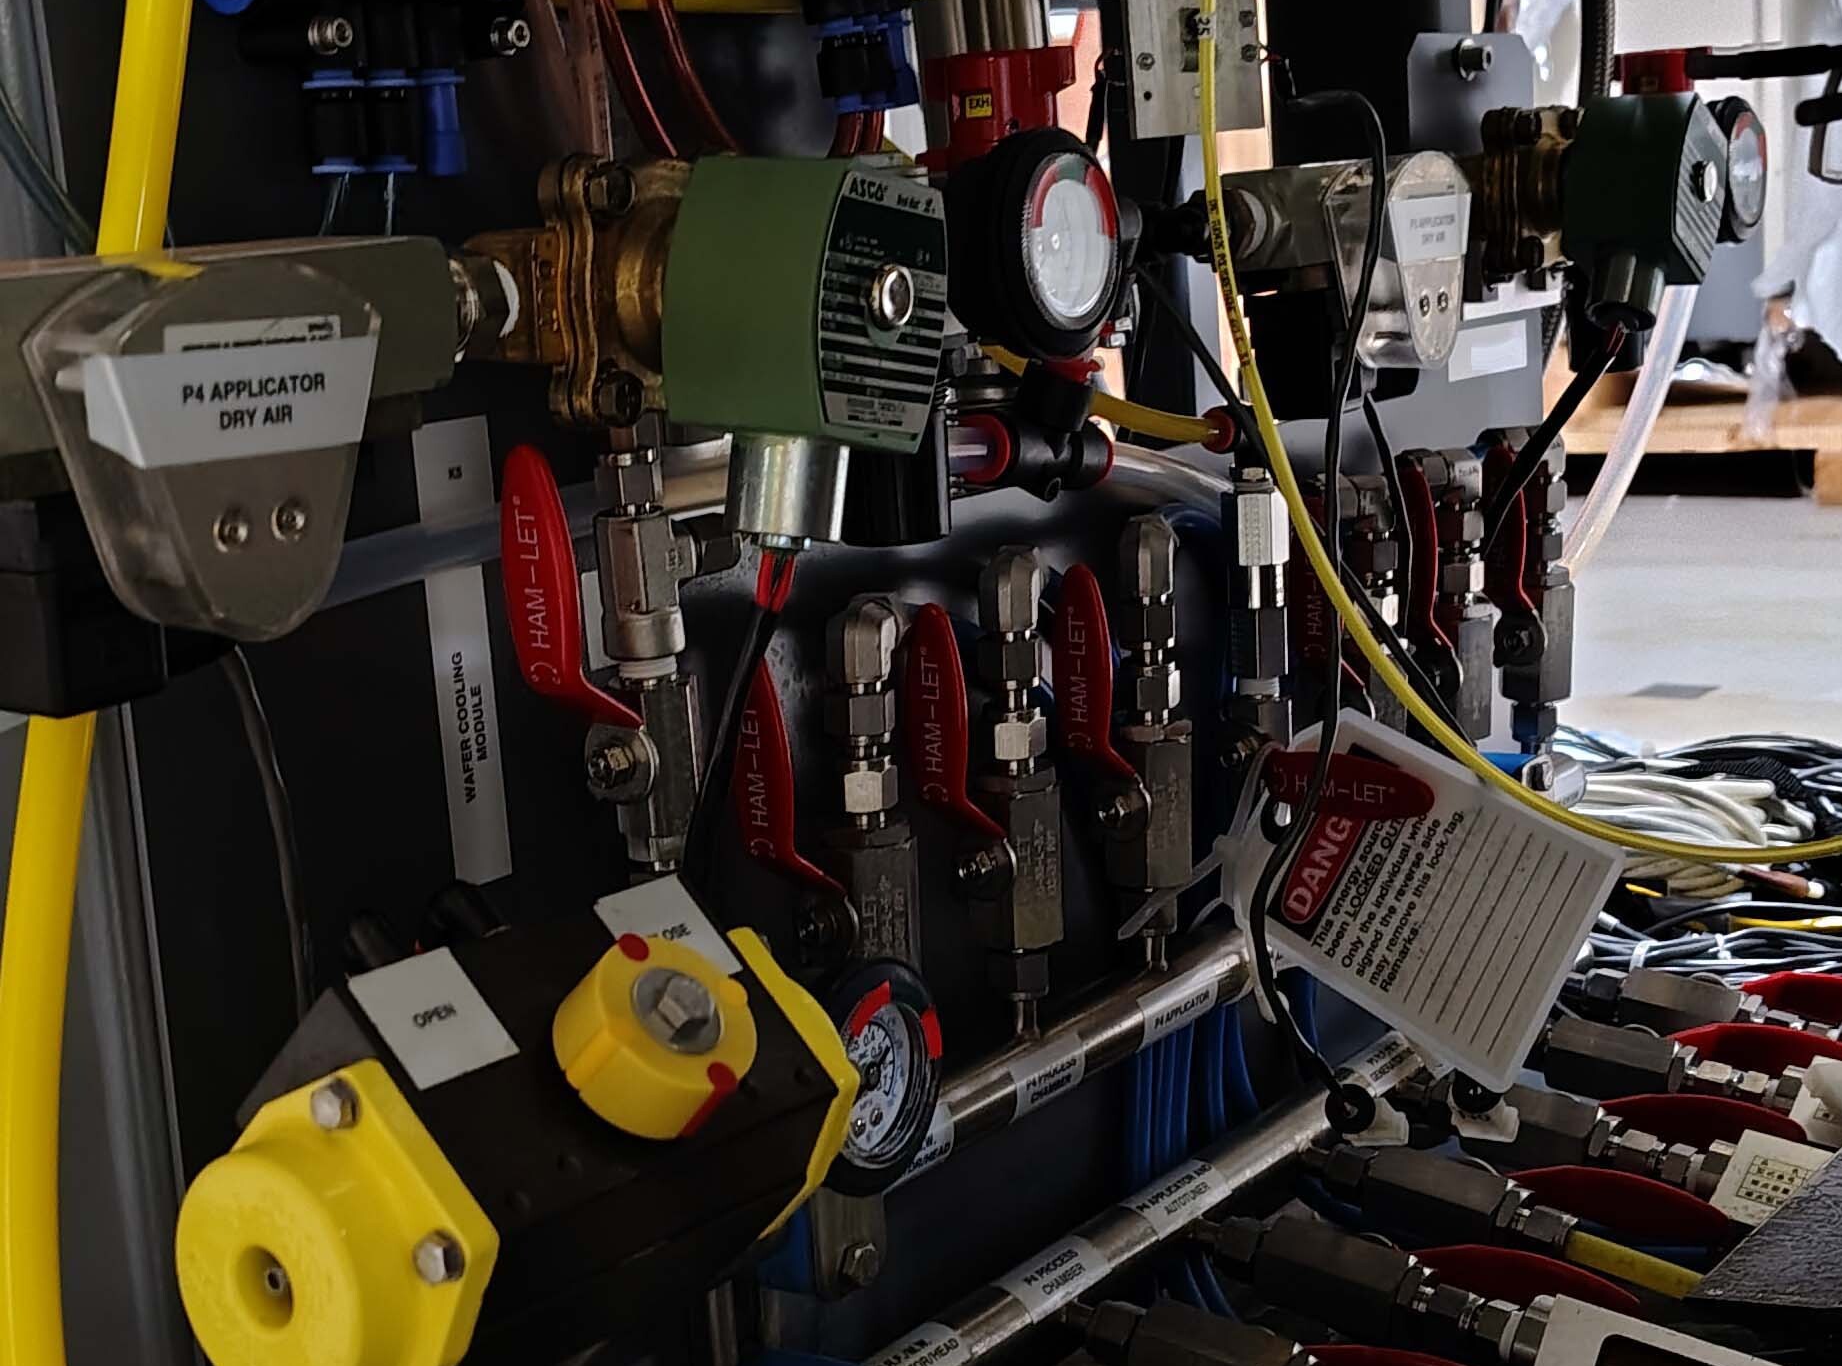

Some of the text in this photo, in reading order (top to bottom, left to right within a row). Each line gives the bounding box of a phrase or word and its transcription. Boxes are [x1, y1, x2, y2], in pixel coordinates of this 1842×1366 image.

[182, 373, 325, 405] P4 APPLICATOR
[219, 404, 293, 431] DRY AIR
[514, 507, 551, 650] HAM-LET
[1068, 618, 1089, 724] HAM-LET
[452, 651, 477, 804] WAFER COOLING
[470, 684, 488, 762] MODULE
[920, 656, 949, 774] HAM-LET
[1294, 774, 1387, 805] HM-LET
[1287, 815, 1353, 917] DANG
[1324, 920, 1350, 959] been
[1344, 853, 1385, 921] LOCKED
[1341, 813, 1428, 968] Only the individual who
[1356, 818, 1441, 978] signed the reverse side
[1310, 918, 1335, 948] This
[1331, 865, 1363, 916] energy
[1369, 954, 1391, 986] may
[1385, 901, 1417, 953] remove
[1411, 872, 1432, 899] this
[1379, 921, 1422, 993] Remarks:
[413, 1003, 456, 1029] OPEN
[1165, 989, 1210, 1023] APPLICATOR
[1148, 1174, 1197, 1206] APPLICATOR
[1193, 1163, 1212, 1177] AND
[1035, 1248, 1079, 1278] PROCESS
[1042, 1262, 1086, 1295] CHAMBER
